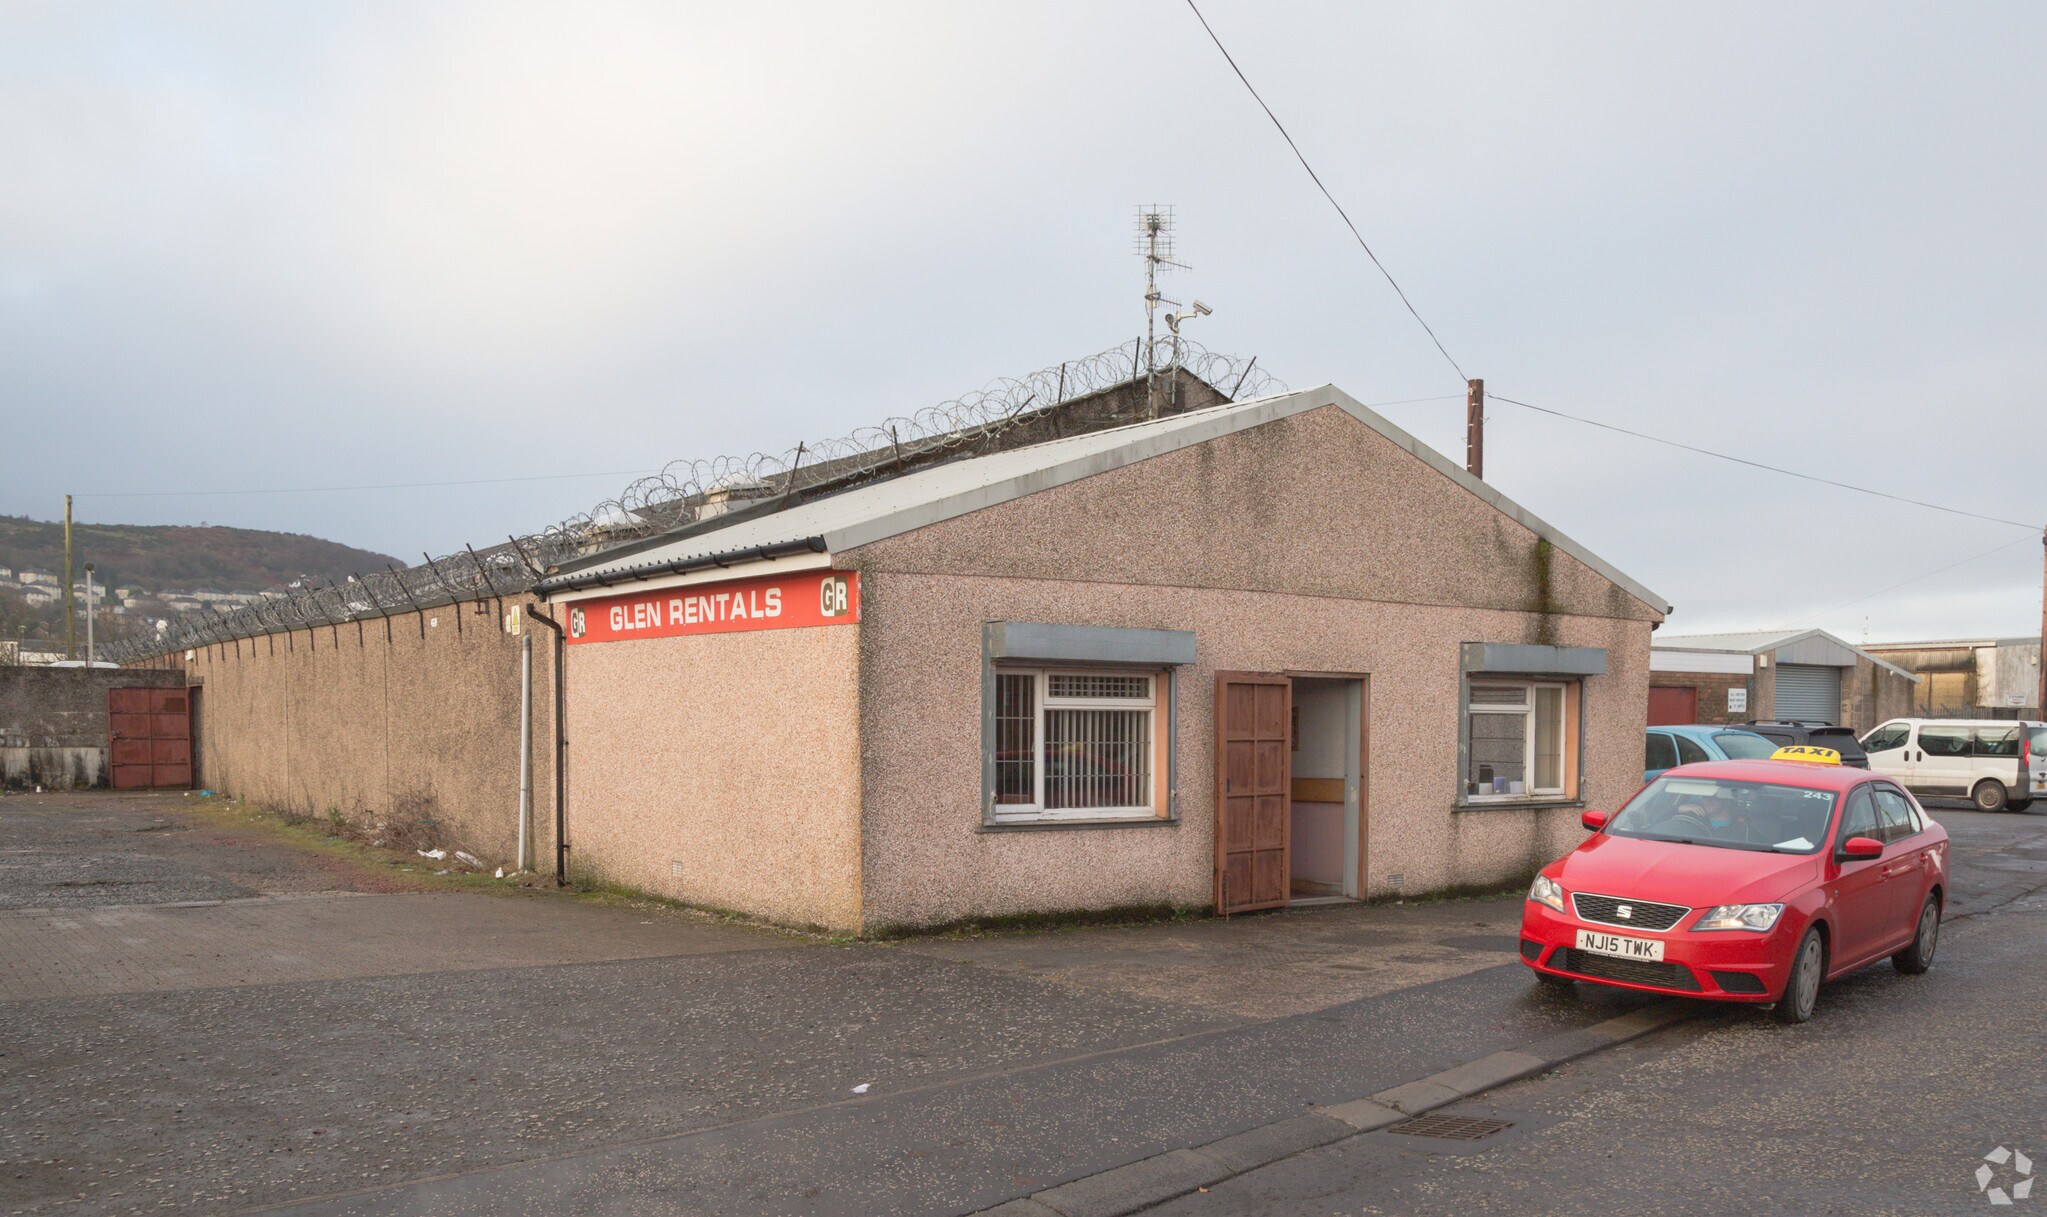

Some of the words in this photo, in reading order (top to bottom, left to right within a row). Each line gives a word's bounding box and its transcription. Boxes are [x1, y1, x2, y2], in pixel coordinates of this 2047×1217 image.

[822, 581, 848, 612] GR
[610, 602, 661, 631] GLEN
[669, 587, 782, 625] RENTALS
[572, 610, 586, 635] GR
[1783, 747, 1834, 757] TAXI
[1803, 791, 1833, 801] 243
[1585, 933, 1619, 952] NJ15
[1623, 939, 1654, 957] TWK
